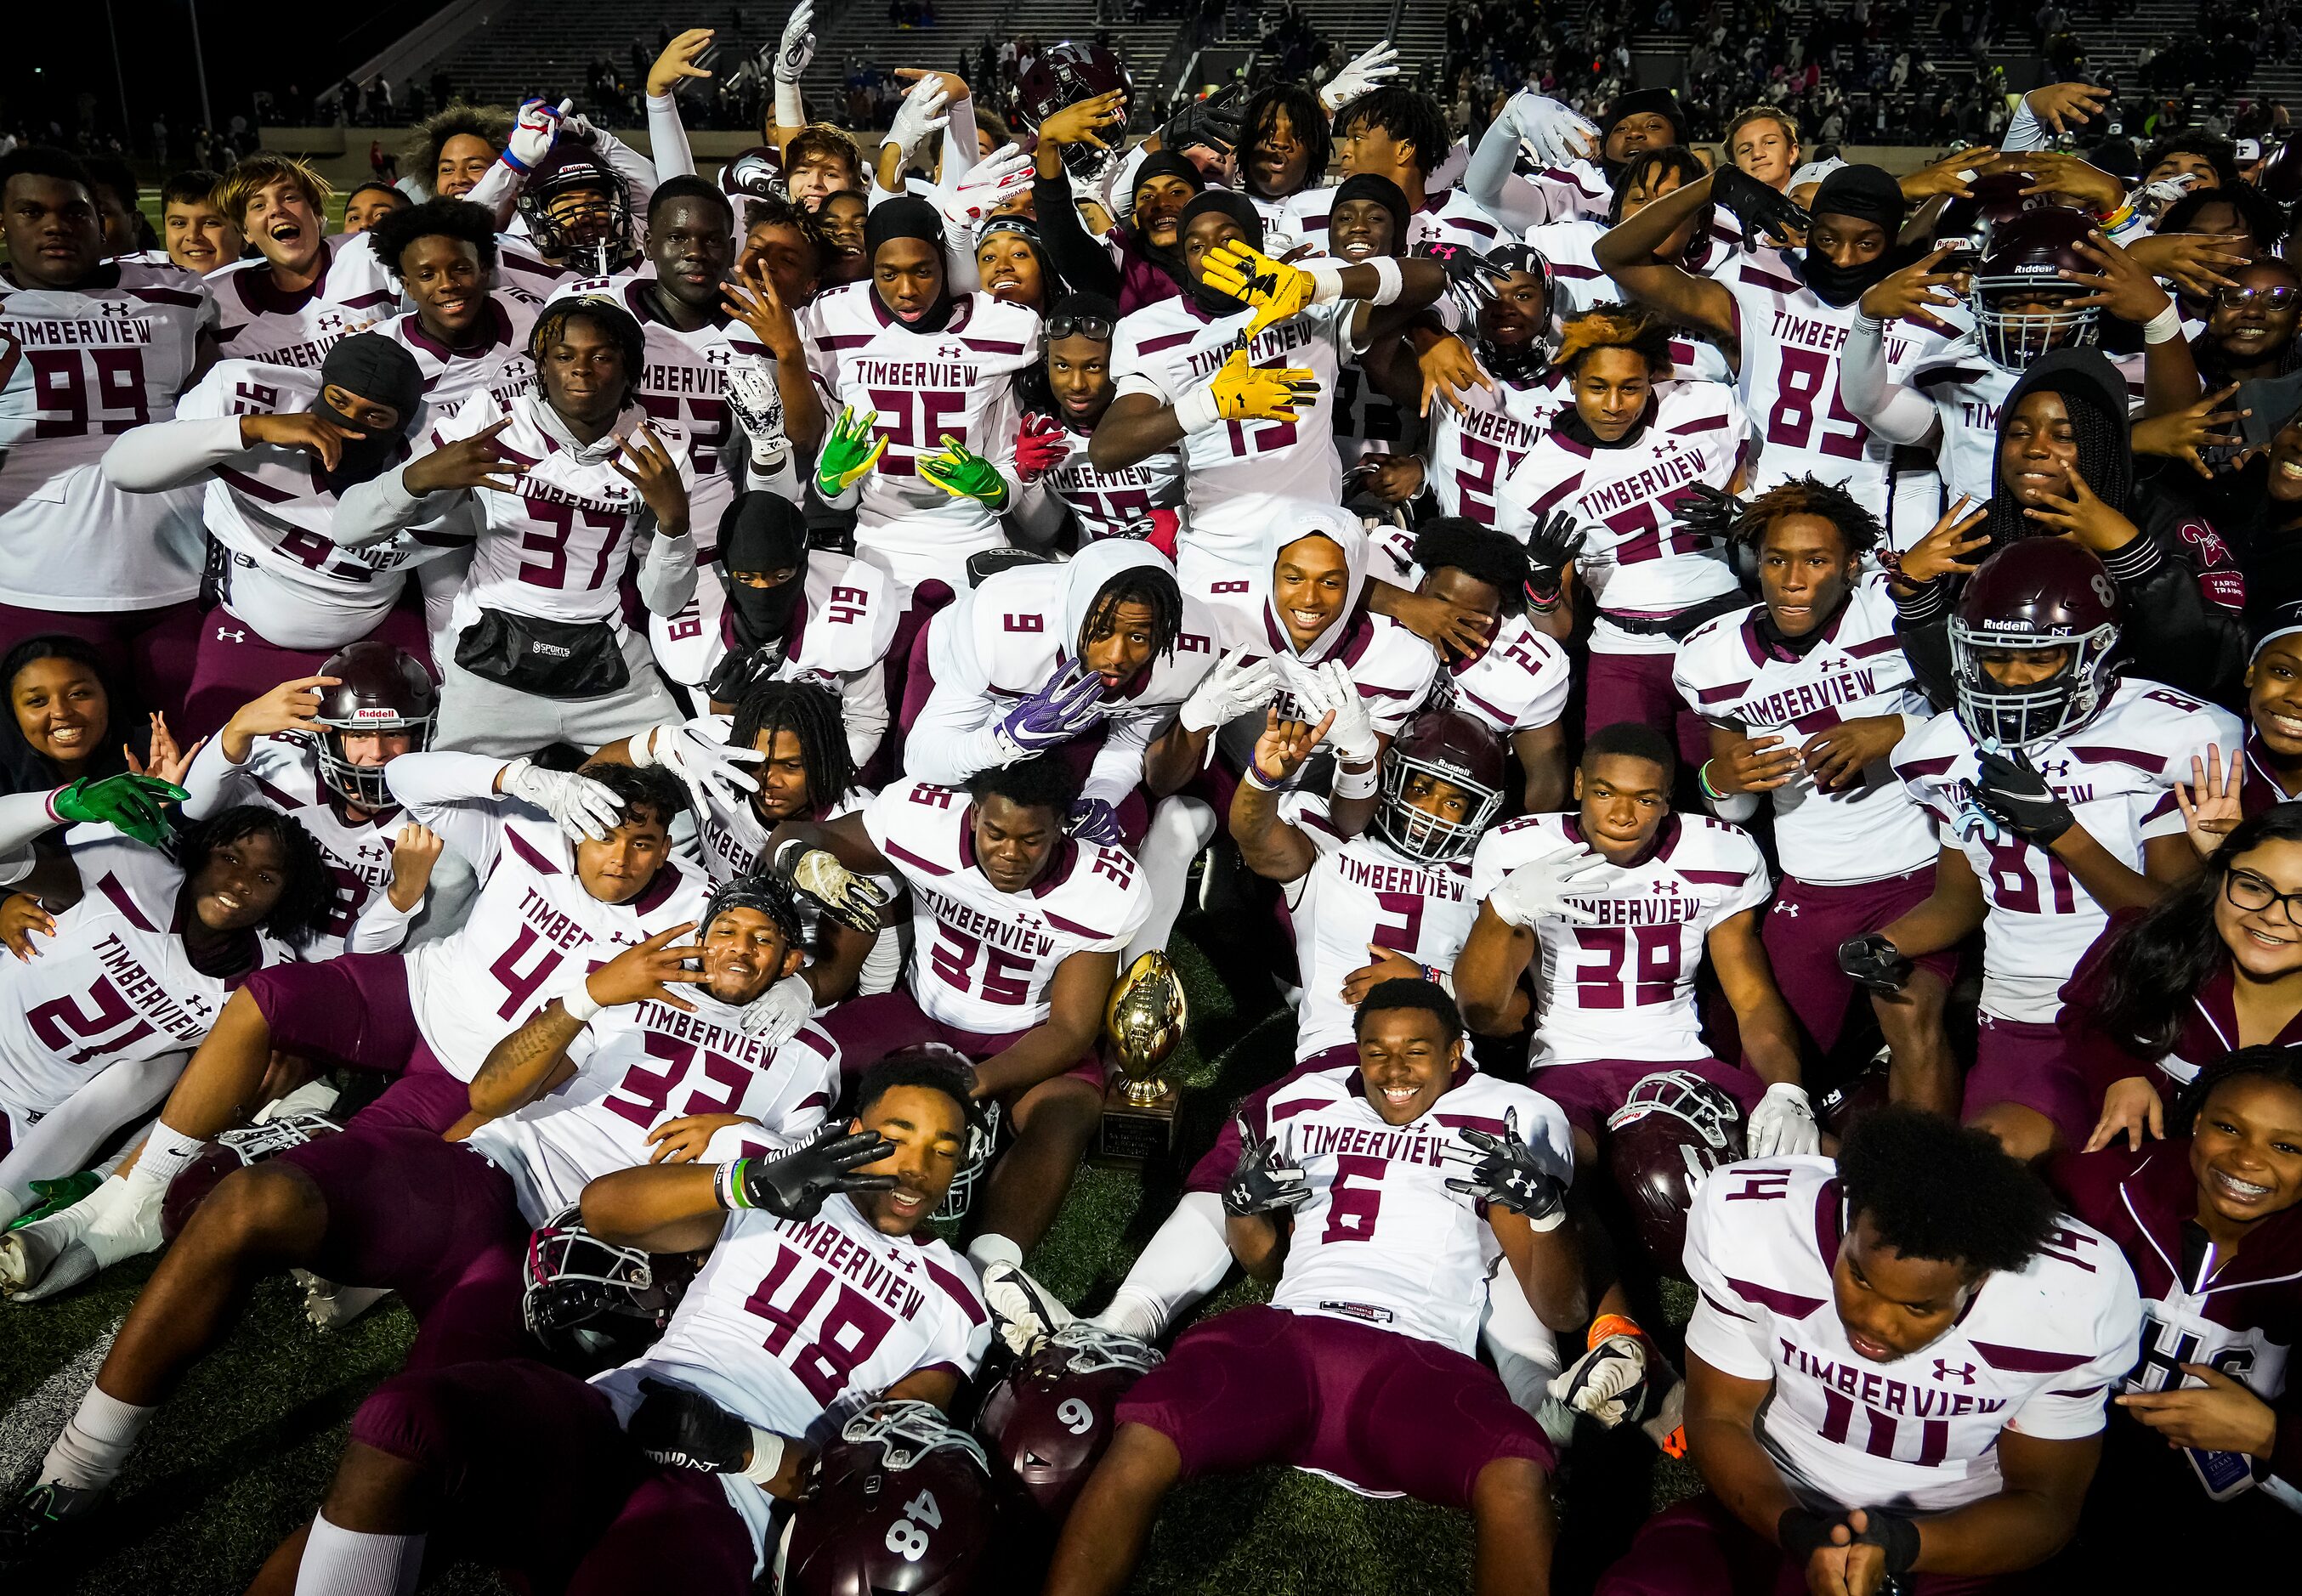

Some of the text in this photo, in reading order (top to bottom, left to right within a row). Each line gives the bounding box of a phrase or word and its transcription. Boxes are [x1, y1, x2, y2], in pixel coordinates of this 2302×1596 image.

[998, 186, 1028, 202] COUGARS
[856, 360, 978, 387] TIMBERVIEW
[1187, 319, 1313, 376] TIMBRVIEW
[24, 348, 150, 439] 99
[867, 389, 967, 477] 25
[1578, 449, 1707, 519] TIMBERVIEW
[518, 497, 627, 591] 37
[829, 586, 869, 625] 49
[1211, 580, 1250, 593] 8
[541, 643, 570, 654] SPORTS
[1504, 630, 1551, 676] 27
[1983, 620, 2028, 631] Riddell
[359, 710, 394, 718] Riddell
[1735, 667, 1877, 725] TIMBERVIEW
[1437, 758, 1471, 777] Riddell
[1091, 847, 1136, 891] 35
[1338, 852, 1465, 903] TIMBERVIEW
[925, 891, 1055, 958] TIMBERVIEW
[93, 932, 206, 1042] TIMBERVIEW
[930, 927, 1037, 1006] 35
[1573, 923, 1682, 1009] 39
[26, 973, 158, 1064] 21
[633, 1000, 780, 1072] TIMBERVIEW
[1303, 1124, 1451, 1168] TIMBERVIEW
[1322, 1154, 1389, 1245] 6
[1726, 1169, 1792, 1202] 14
[2040, 1227, 2098, 1274] 14
[745, 1243, 896, 1411] 48
[1779, 1337, 2008, 1418] TIMBERVIEW
[885, 1488, 943, 1562] 48
